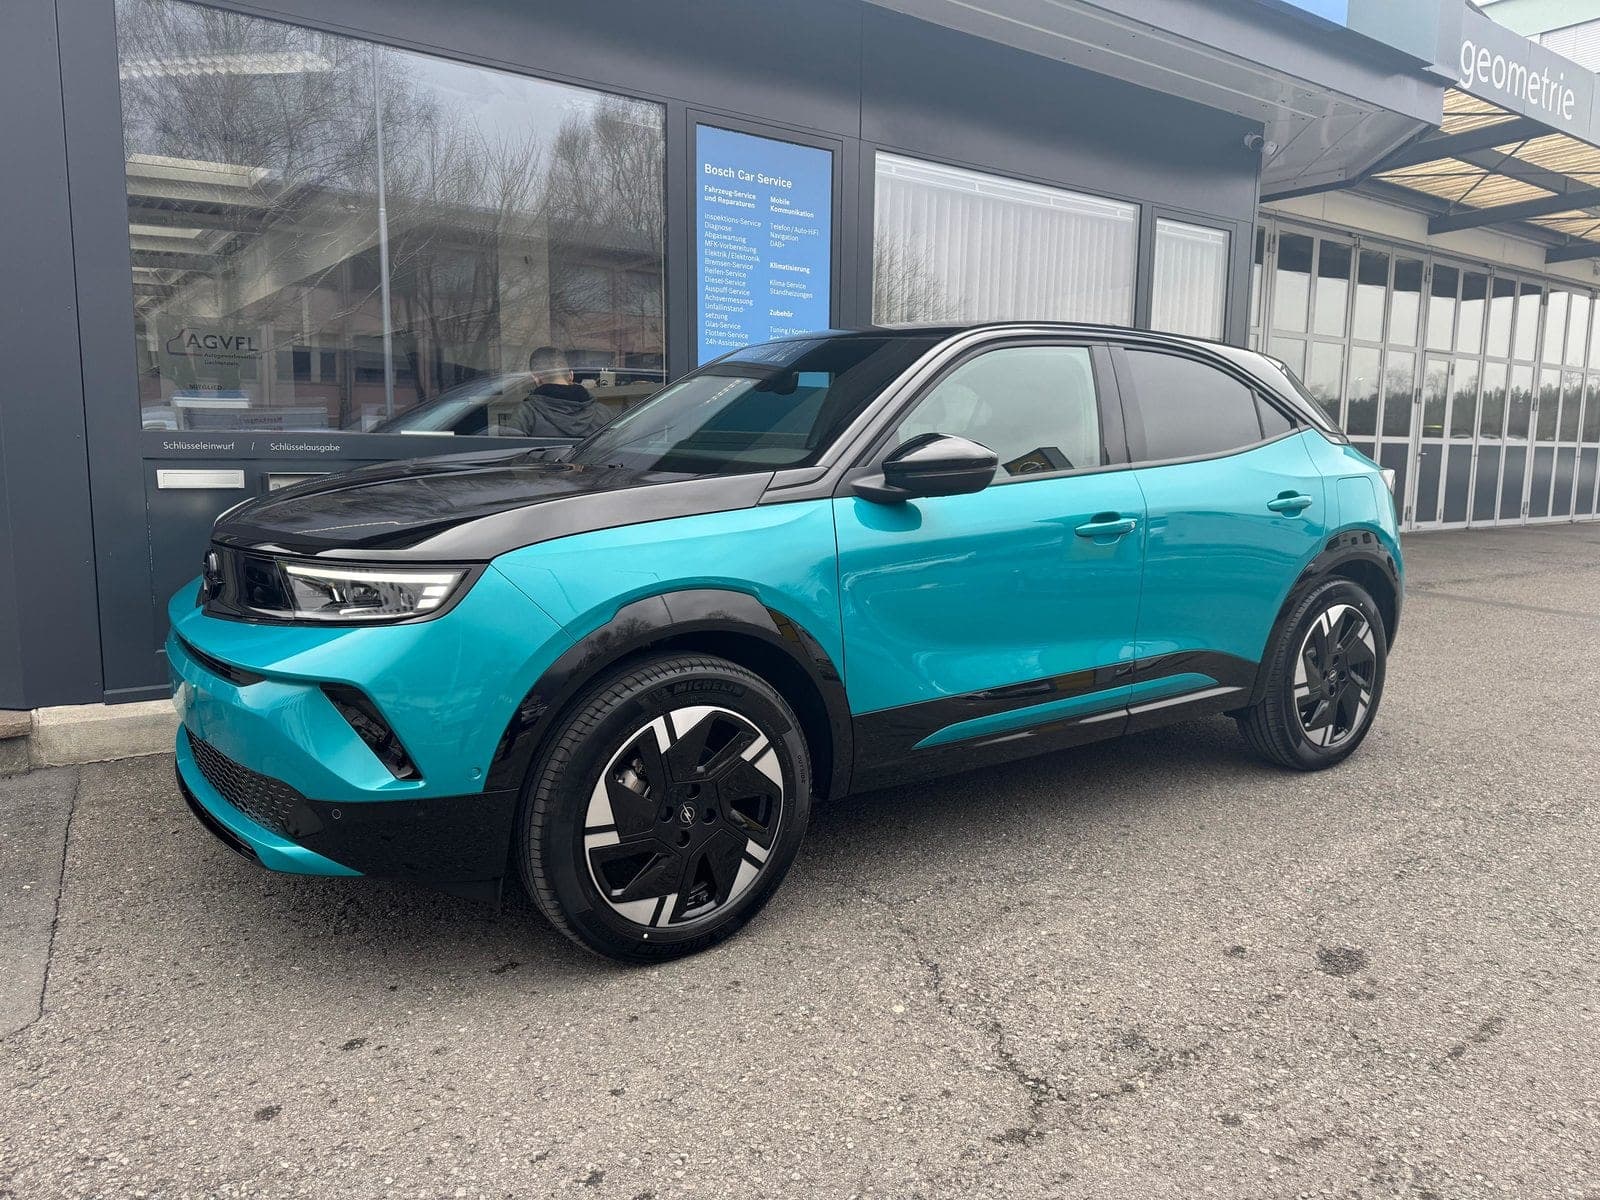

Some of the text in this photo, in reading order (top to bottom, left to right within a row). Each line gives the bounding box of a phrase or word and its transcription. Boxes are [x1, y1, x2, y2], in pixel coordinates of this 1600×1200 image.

[1459, 40, 1575, 120] geometrie
[704, 163, 792, 189] Bosch Car Service
[717, 197, 755, 209] Reparaturen
[769, 196, 790, 206] Mobile
[769, 205, 815, 219] Kommunikation
[704, 221, 732, 232] Diagnose
[769, 231, 799, 242] Navigation
[769, 262, 811, 275] Klimatisierung
[769, 309, 794, 317] Zubehör
[186, 333, 259, 351] AGVFL
[163, 441, 235, 450] Schlüsseleinwurf
[270, 442, 340, 452] Schlüsselausgabe
[673, 679, 743, 696] MICHELIN
